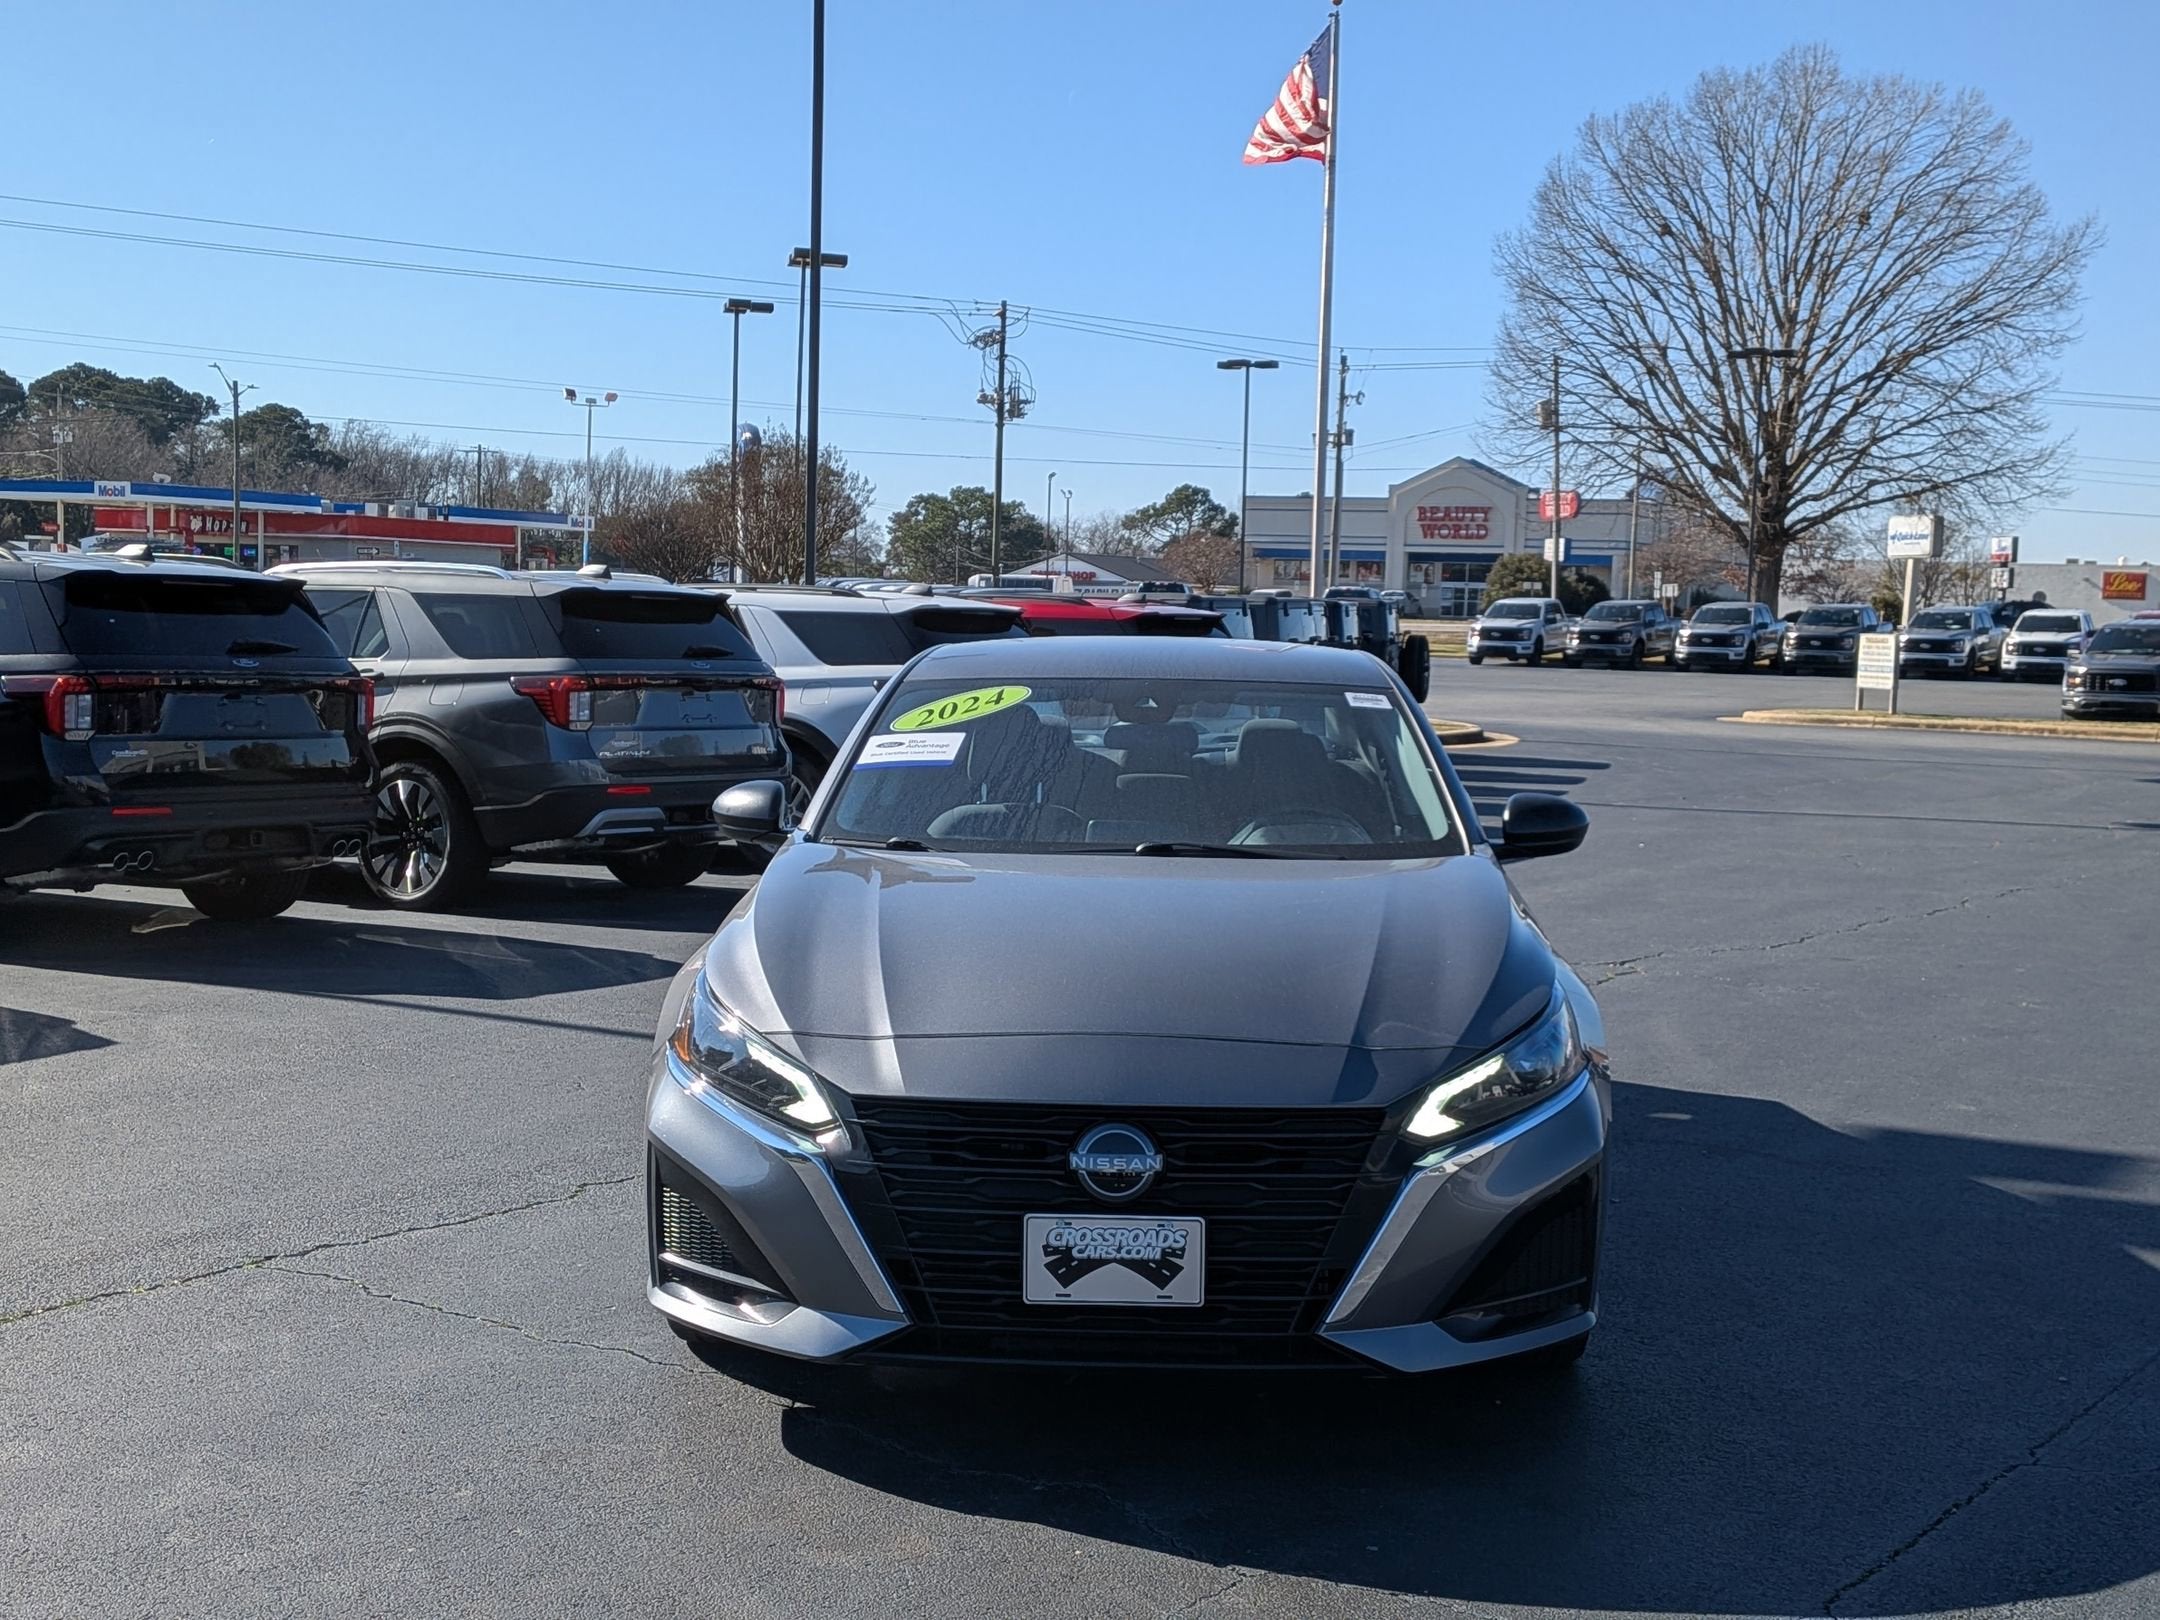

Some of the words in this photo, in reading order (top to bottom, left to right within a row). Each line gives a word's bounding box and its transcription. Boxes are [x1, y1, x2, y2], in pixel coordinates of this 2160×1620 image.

[98, 485, 126, 497] Mobil
[1417, 506, 1492, 522] BEAUTY
[1420, 523, 1488, 539] WORLD
[915, 688, 1004, 727] 2024
[1072, 1156, 1161, 1170] NISSAN
[1047, 1227, 1189, 1249] CROSSROADS
[1071, 1245, 1162, 1260] CARS.COM
